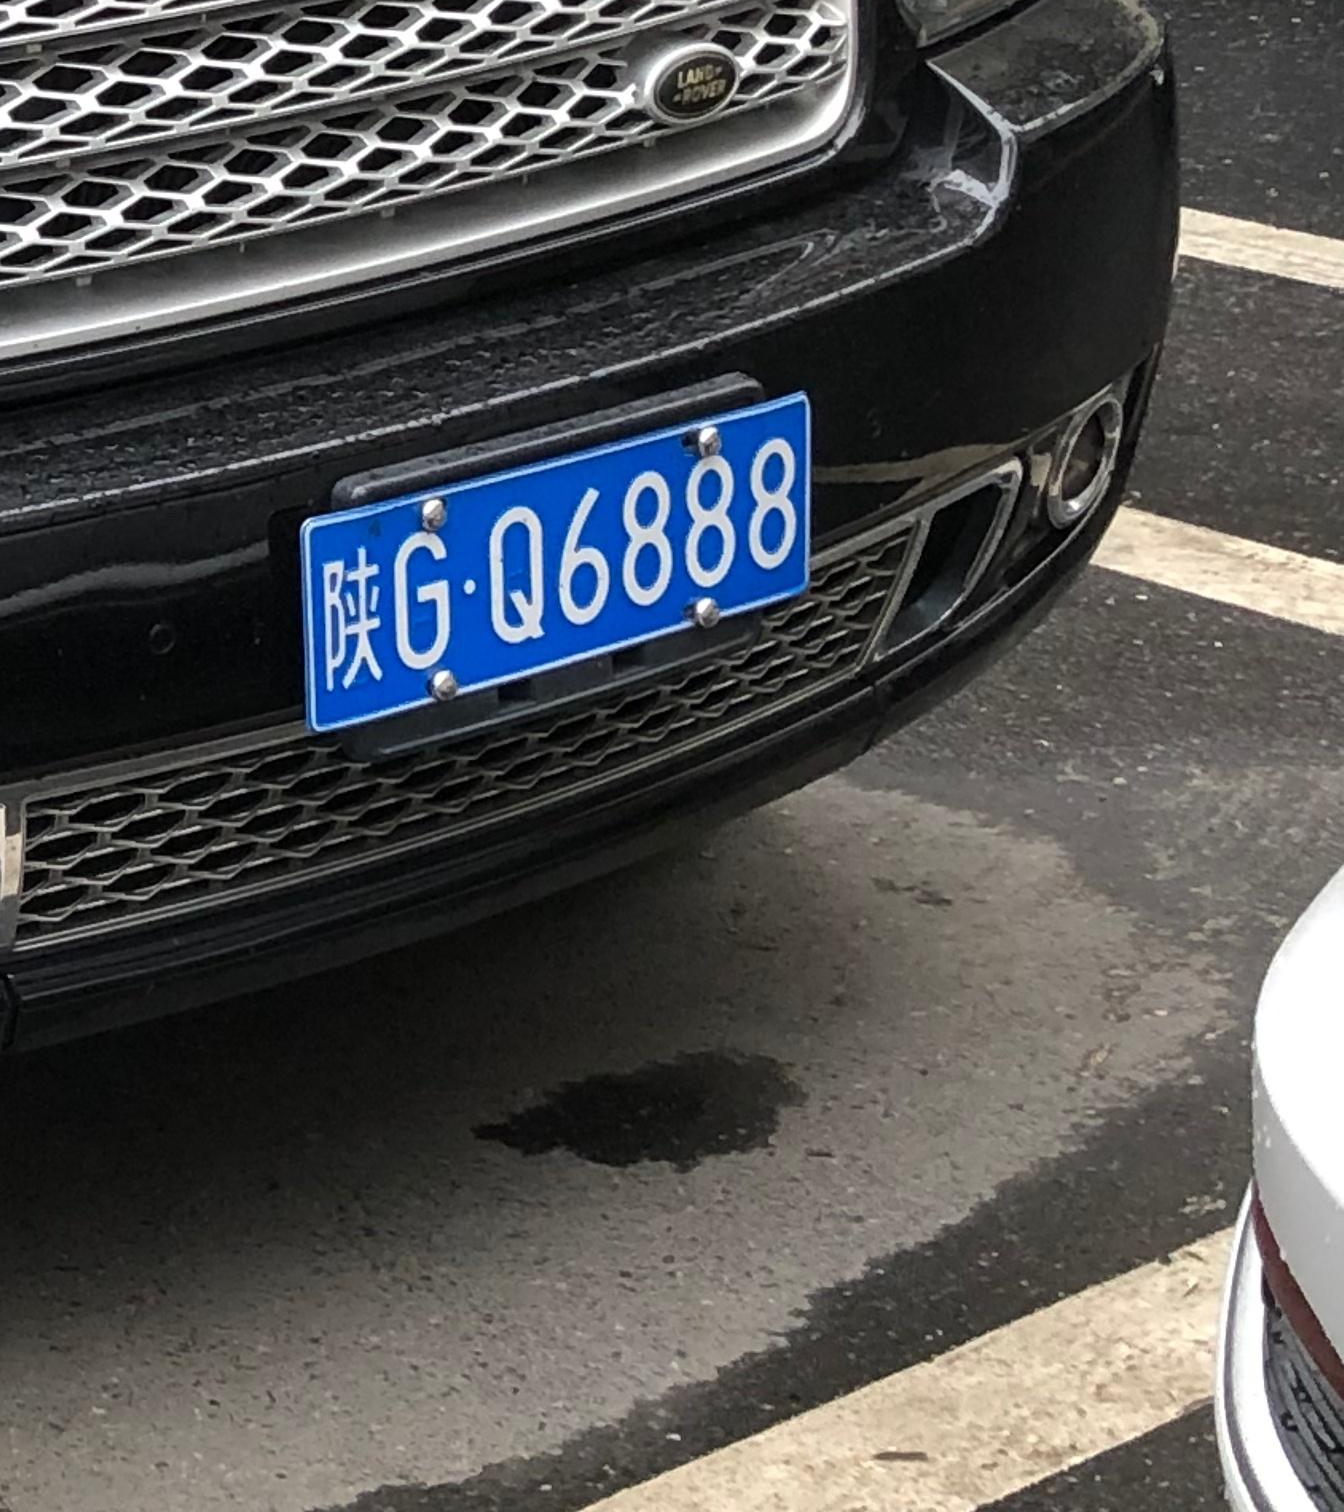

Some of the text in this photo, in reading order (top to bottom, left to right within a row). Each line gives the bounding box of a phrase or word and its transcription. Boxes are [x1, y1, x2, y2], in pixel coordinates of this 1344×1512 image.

[676, 64, 715, 89] LAND
[681, 79, 727, 105] ROVER
[323, 437, 798, 691] 陕G·Q6888
